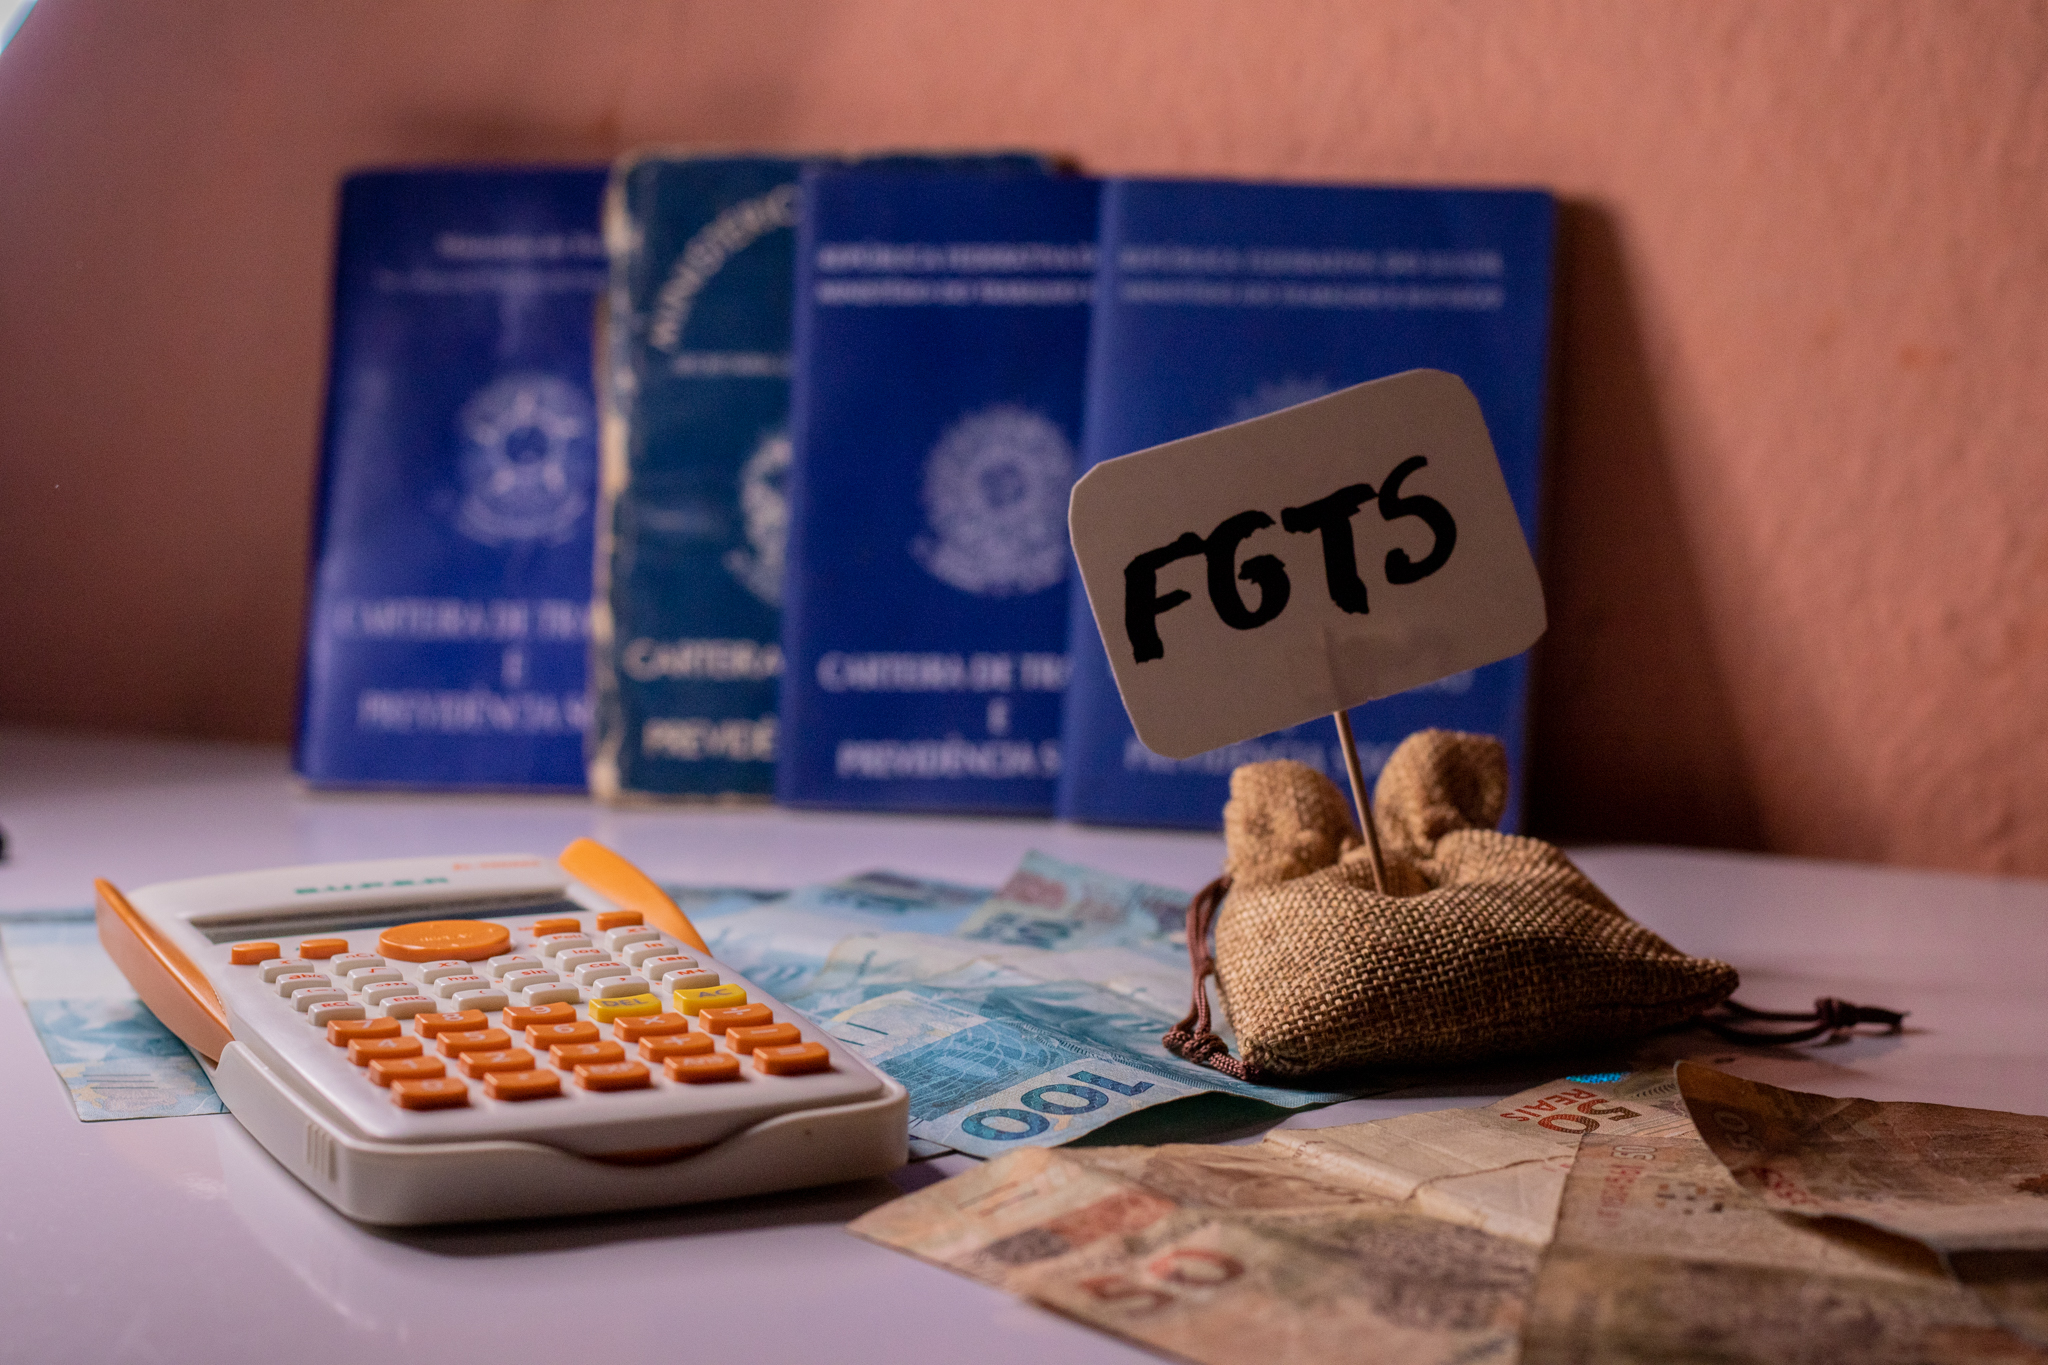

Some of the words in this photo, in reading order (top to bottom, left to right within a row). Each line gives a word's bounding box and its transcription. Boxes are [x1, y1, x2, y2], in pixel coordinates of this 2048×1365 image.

[1123, 455, 1457, 665] FGTS
[698, 987, 733, 999] AC
[600, 996, 649, 1008] DEL
[529, 1005, 552, 1015] 9
[441, 1012, 464, 1022] 8
[552, 1024, 575, 1034] 6
[960, 1068, 1156, 1142] 100
[1499, 1087, 1599, 1122] REAIS
[1537, 1098, 1643, 1135] 50
